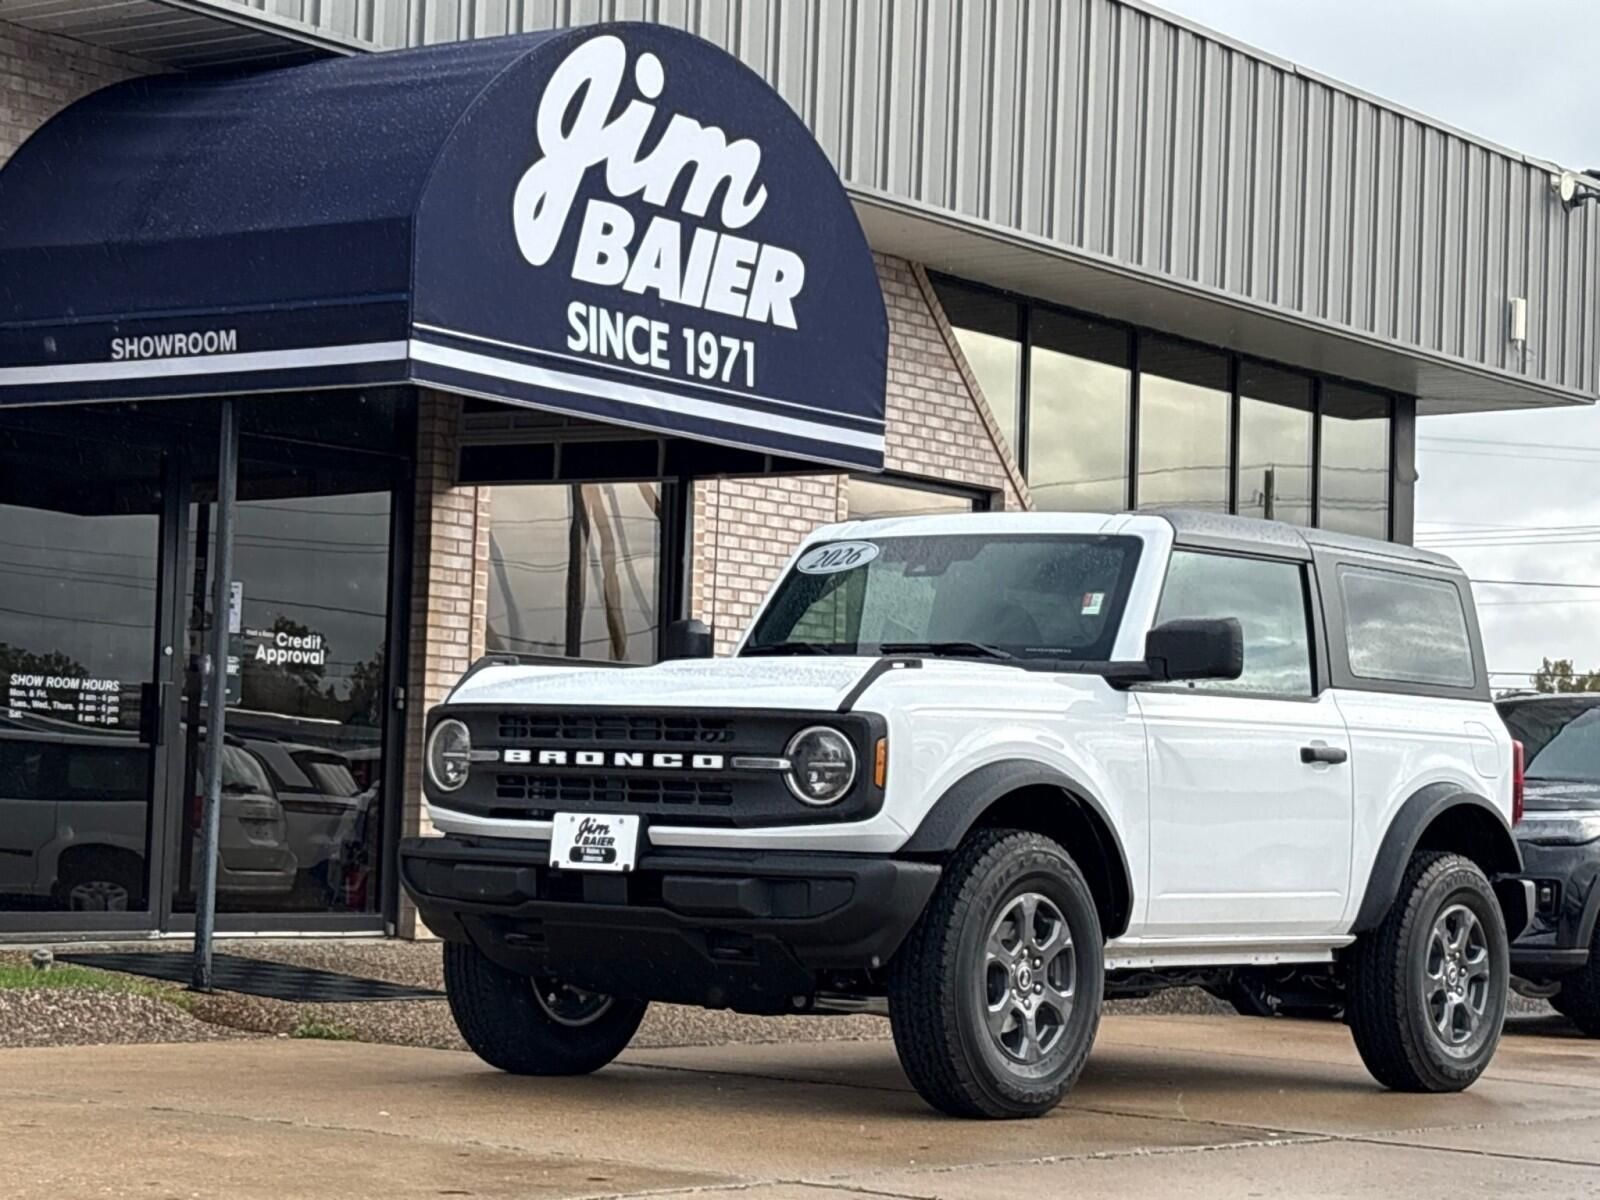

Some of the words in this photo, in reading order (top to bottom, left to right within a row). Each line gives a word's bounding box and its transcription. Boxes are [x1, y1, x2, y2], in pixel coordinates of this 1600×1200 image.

[513, 35, 768, 266] Jim
[571, 198, 805, 330] BAIER
[111, 329, 237, 359] SHOWROOM
[567, 301, 670, 370] SINCE
[682, 328, 755, 387] 1971
[807, 546, 871, 569] 2026
[276, 632, 321, 649] Credit
[255, 643, 325, 665] Approval
[10, 674, 44, 687] SHOW
[46, 677, 80, 689] ROOM
[82, 679, 120, 691] HOURS
[504, 749, 723, 769] BRONCO
[574, 817, 610, 845] Jim
[582, 836, 615, 846] BAIER
